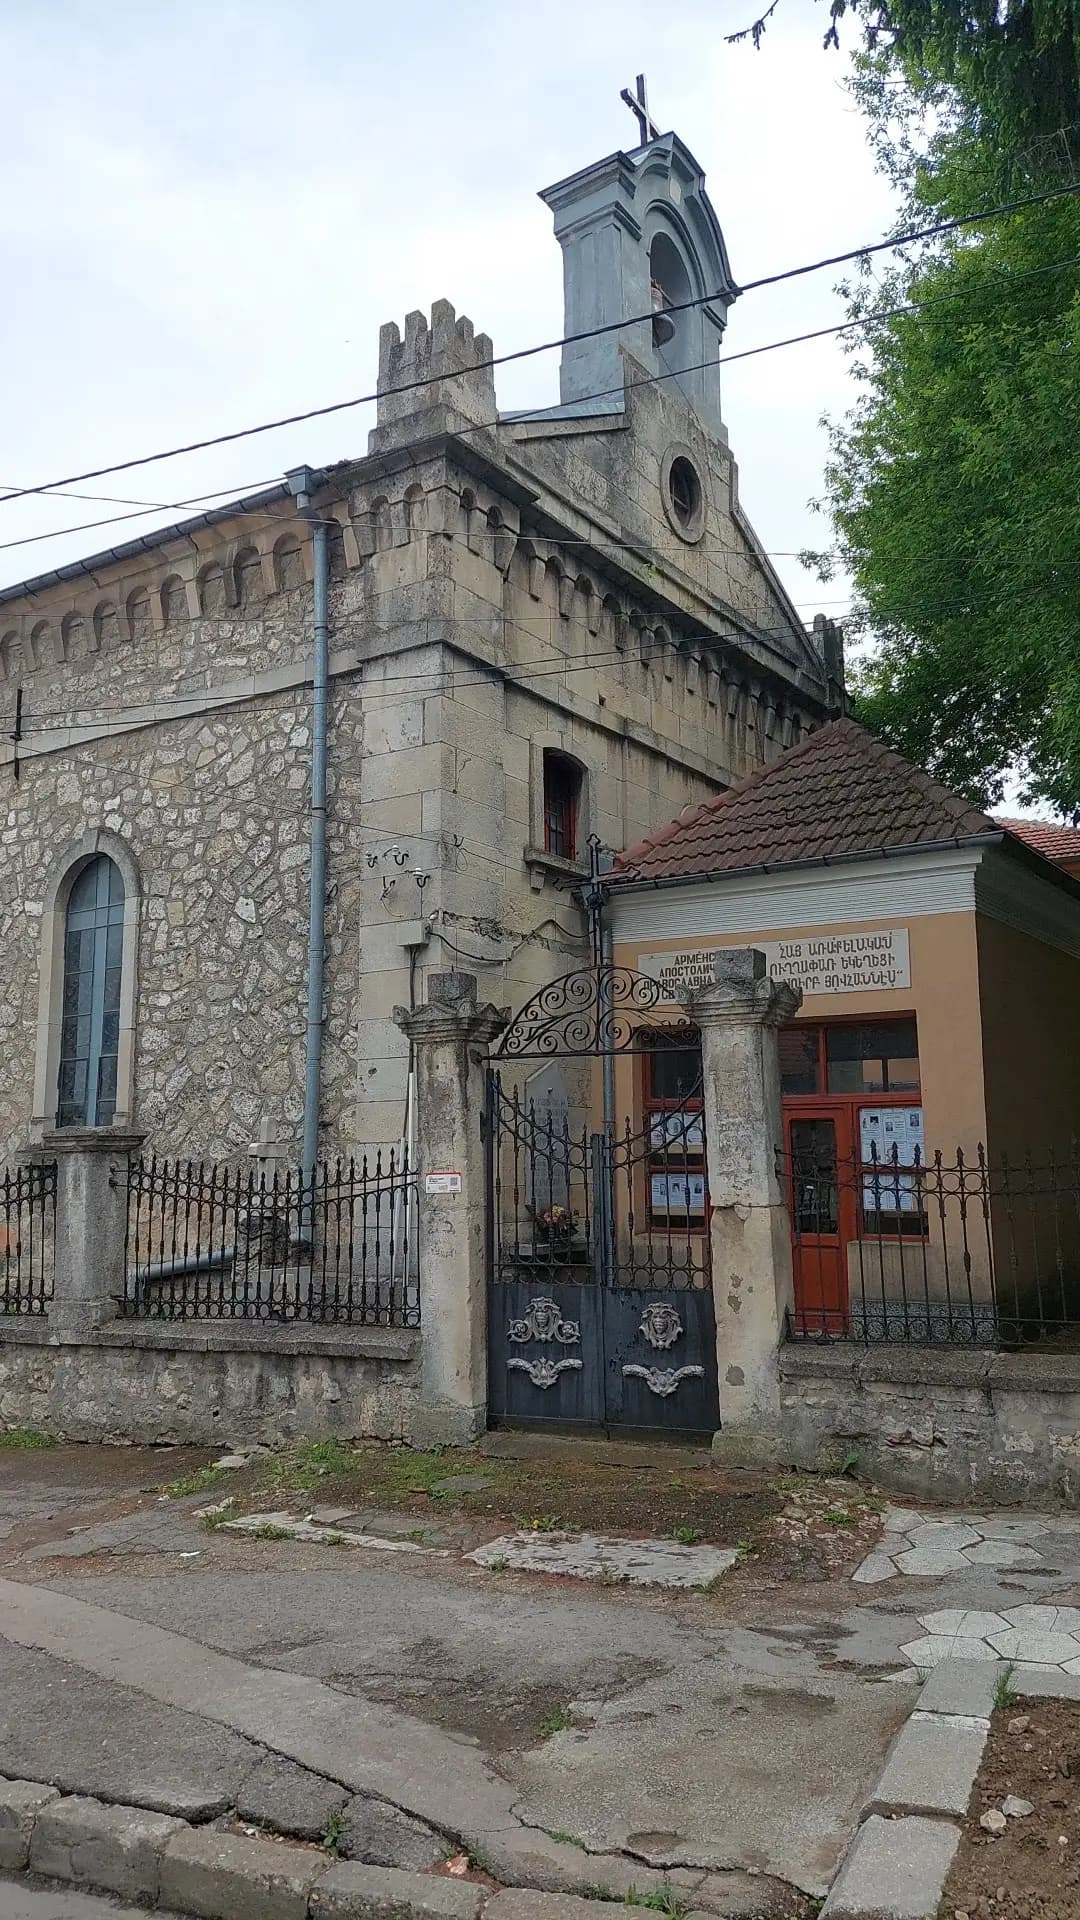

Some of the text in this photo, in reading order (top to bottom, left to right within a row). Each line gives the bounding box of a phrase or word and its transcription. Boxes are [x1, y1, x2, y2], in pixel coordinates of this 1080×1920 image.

[674, 952, 716, 966] АРМЕНС
[780, 944, 802, 960] ՀԱՅ
[841, 953, 895, 969] ԵԿԵՂԵՑԻ
[660, 963, 715, 978] АПОСТОЛИЧ
